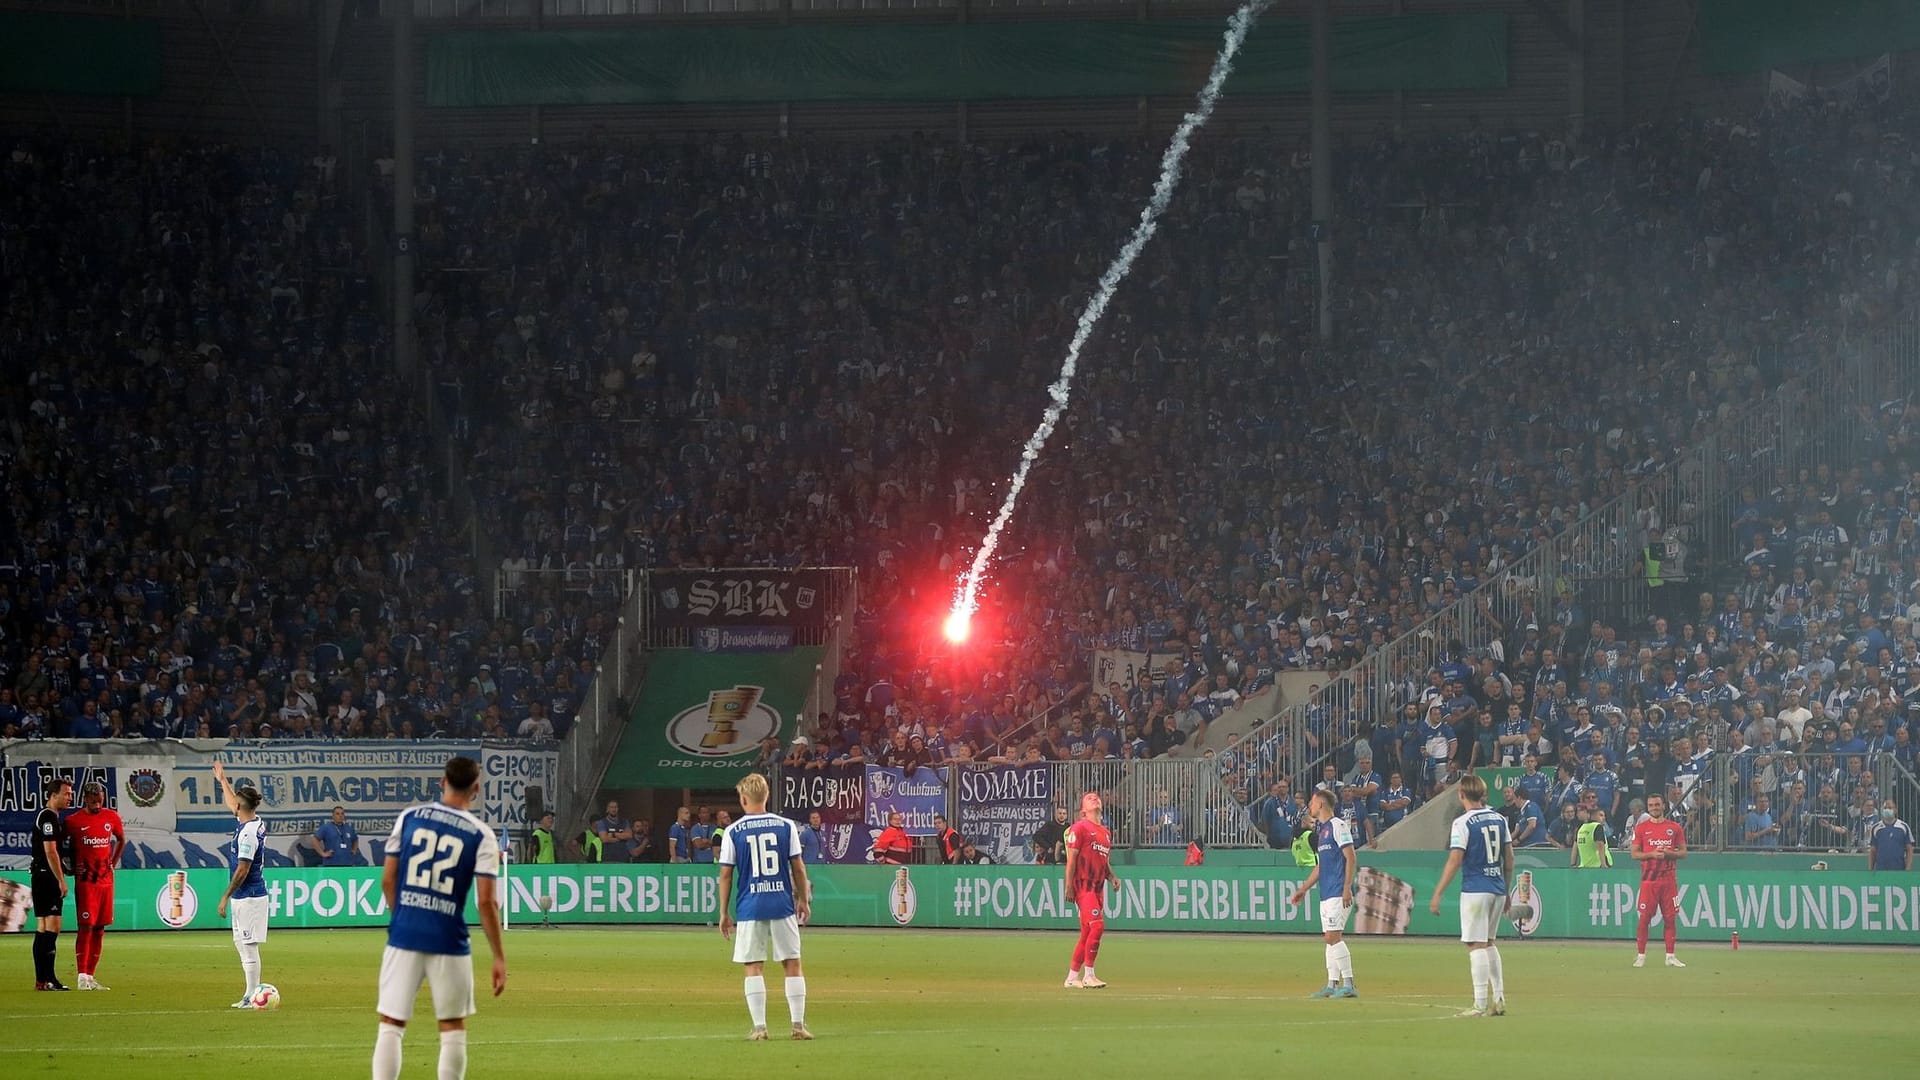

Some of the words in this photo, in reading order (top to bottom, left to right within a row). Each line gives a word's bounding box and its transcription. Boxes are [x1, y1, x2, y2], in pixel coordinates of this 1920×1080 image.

[1311, 224, 1320, 238] 7
[399, 238, 408, 251] 6
[687, 579, 790, 617] SBK
[231, 750, 296, 765] KÄMPFEN
[298, 751, 321, 765] MIT
[323, 751, 398, 765] ERHOBENEN
[657, 759, 753, 768] DFB-POKA
[484, 780, 525, 801] 1.FC
[270, 819, 320, 833] UNSERE
[961, 822, 990, 836] CLUB
[406, 827, 464, 895] 22
[746, 832, 779, 878] 16
[954, 877, 1318, 921] #POKALUNDERBLEIBT
